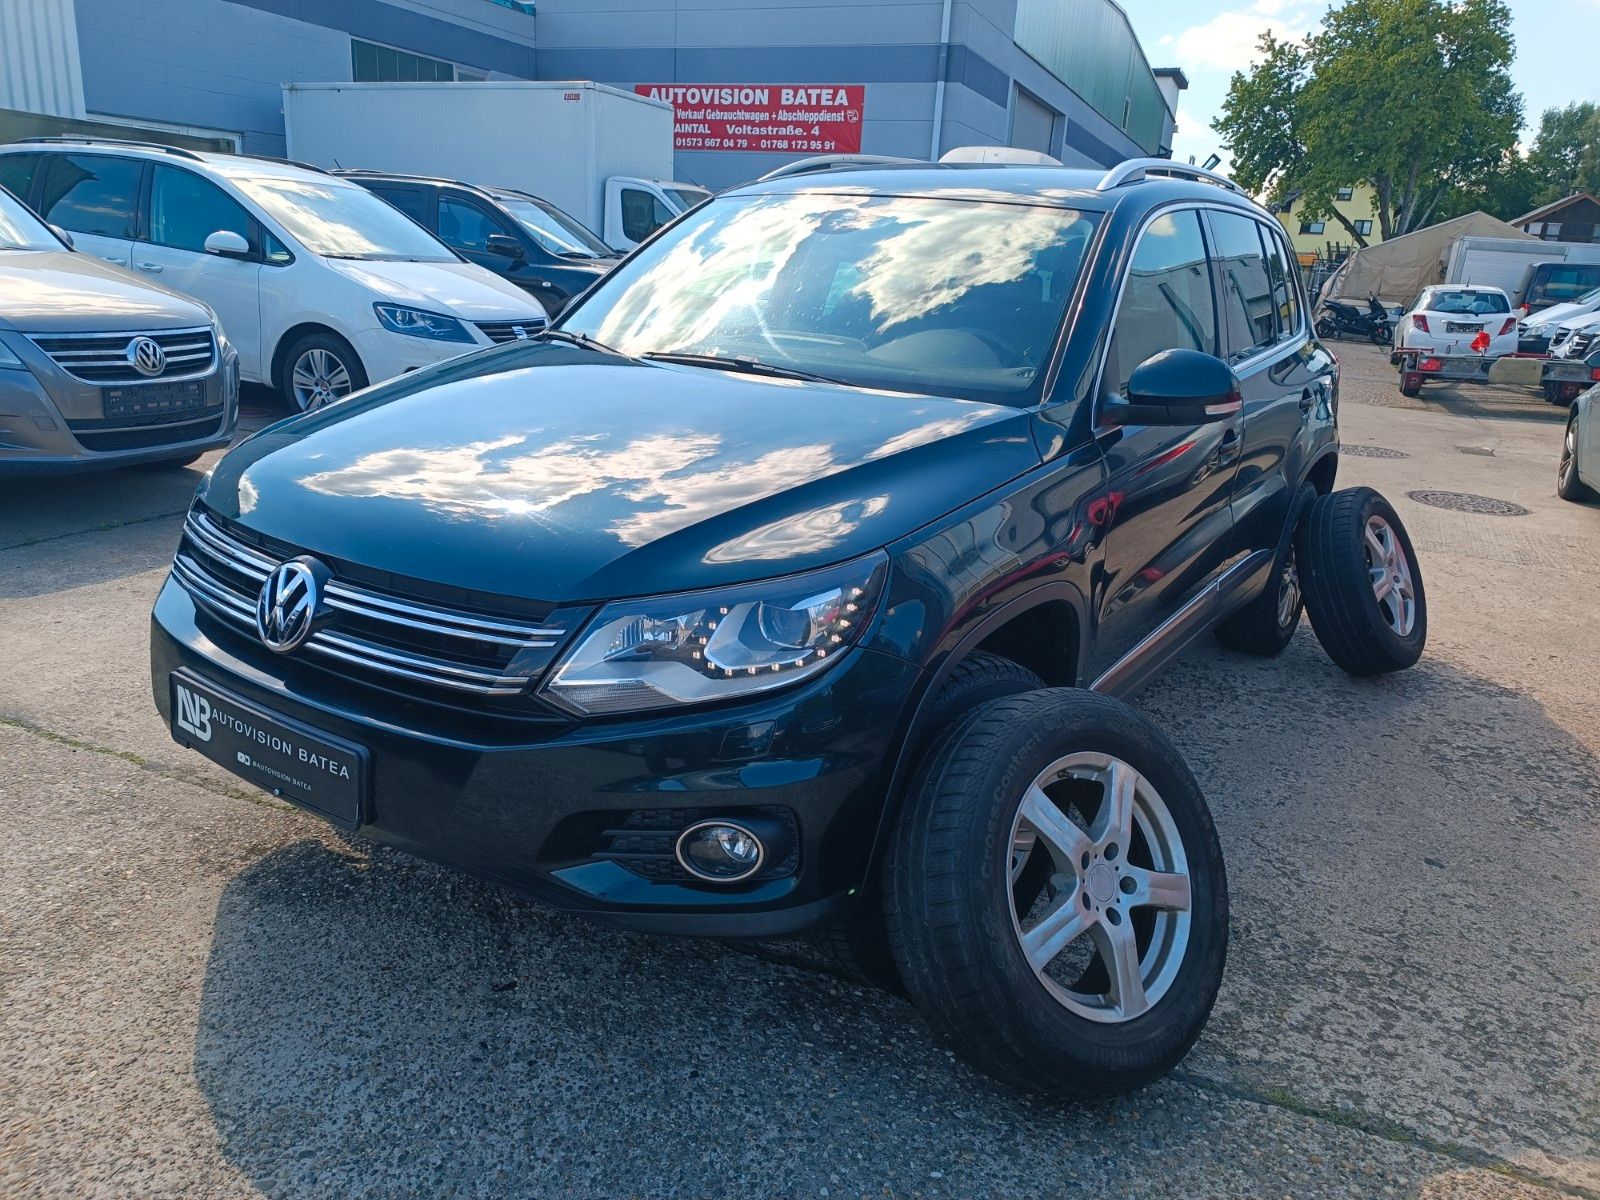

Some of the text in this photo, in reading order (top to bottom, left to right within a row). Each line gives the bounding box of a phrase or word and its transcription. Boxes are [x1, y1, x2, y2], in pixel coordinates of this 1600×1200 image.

[649, 87, 849, 106] AUTOVISION BATEA
[676, 108, 705, 120] Verkauf
[706, 109, 769, 123] Gebrauchtwagen
[777, 109, 845, 124] Abschleppdienst
[726, 124, 807, 136] Voltastraße.
[811, 125, 820, 136] 4
[675, 137, 702, 147] 01573
[723, 138, 735, 148] 04
[737, 139, 748, 148] 79
[760, 139, 788, 149] 01768
[791, 140, 808, 149] 173
[810, 140, 822, 150] 95
[824, 141, 835, 150] 91
[211, 708, 292, 755] AUTOVISION
[298, 747, 350, 780] BATEA
[292, 778, 312, 791] BATEA
